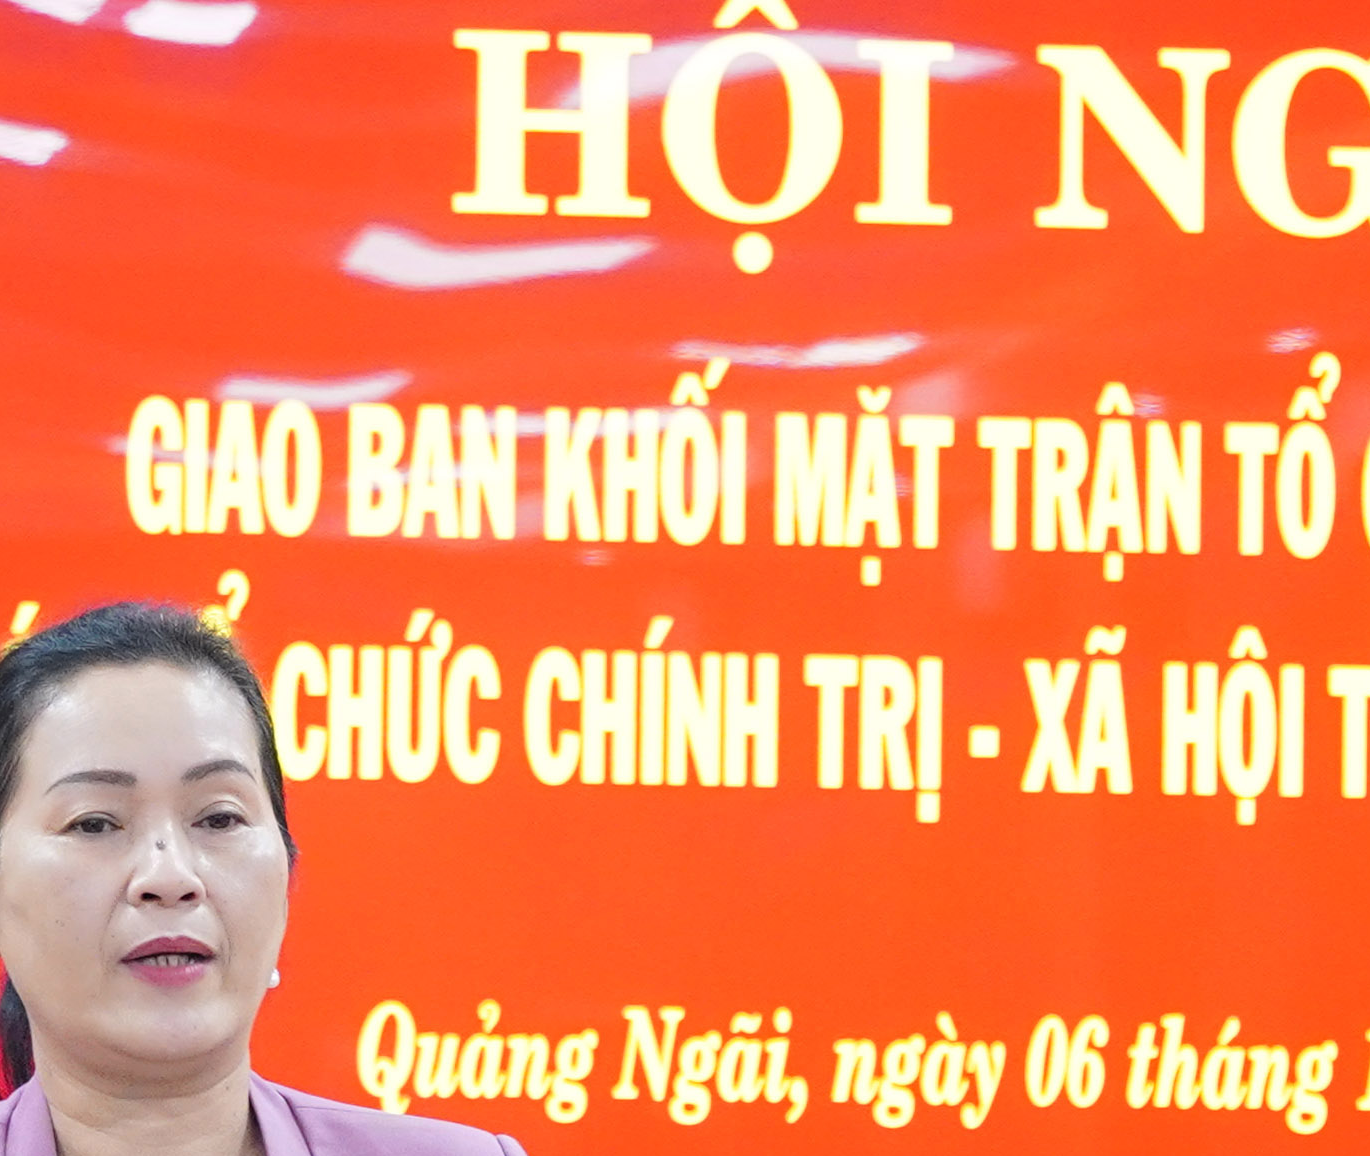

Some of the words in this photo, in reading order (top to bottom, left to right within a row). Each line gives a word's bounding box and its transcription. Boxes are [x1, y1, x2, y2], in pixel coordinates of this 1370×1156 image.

[450, 0, 957, 276] HỘI
[124, 394, 321, 539] GIAO
[344, 402, 516, 542] BAN
[541, 358, 749, 549] KHỐI
[773, 384, 956, 588] MẶT
[975, 380, 1203, 583] TRẬN
[1223, 350, 1337, 560] TỔ
[271, 608, 503, 784] CHỨC
[522, 615, 781, 790] CHÍNH
[802, 653, 944, 825] TRỊ
[1020, 624, 1134, 795] XÃ
[1161, 624, 1306, 826] HỘI
[356, 1000, 600, 1125] Quảng
[610, 1004, 811, 1126] Ngãi,
[829, 1011, 1007, 1130] ngày
[1025, 1014, 1111, 1110] 06
[1125, 1013, 1340, 1136] tháng
